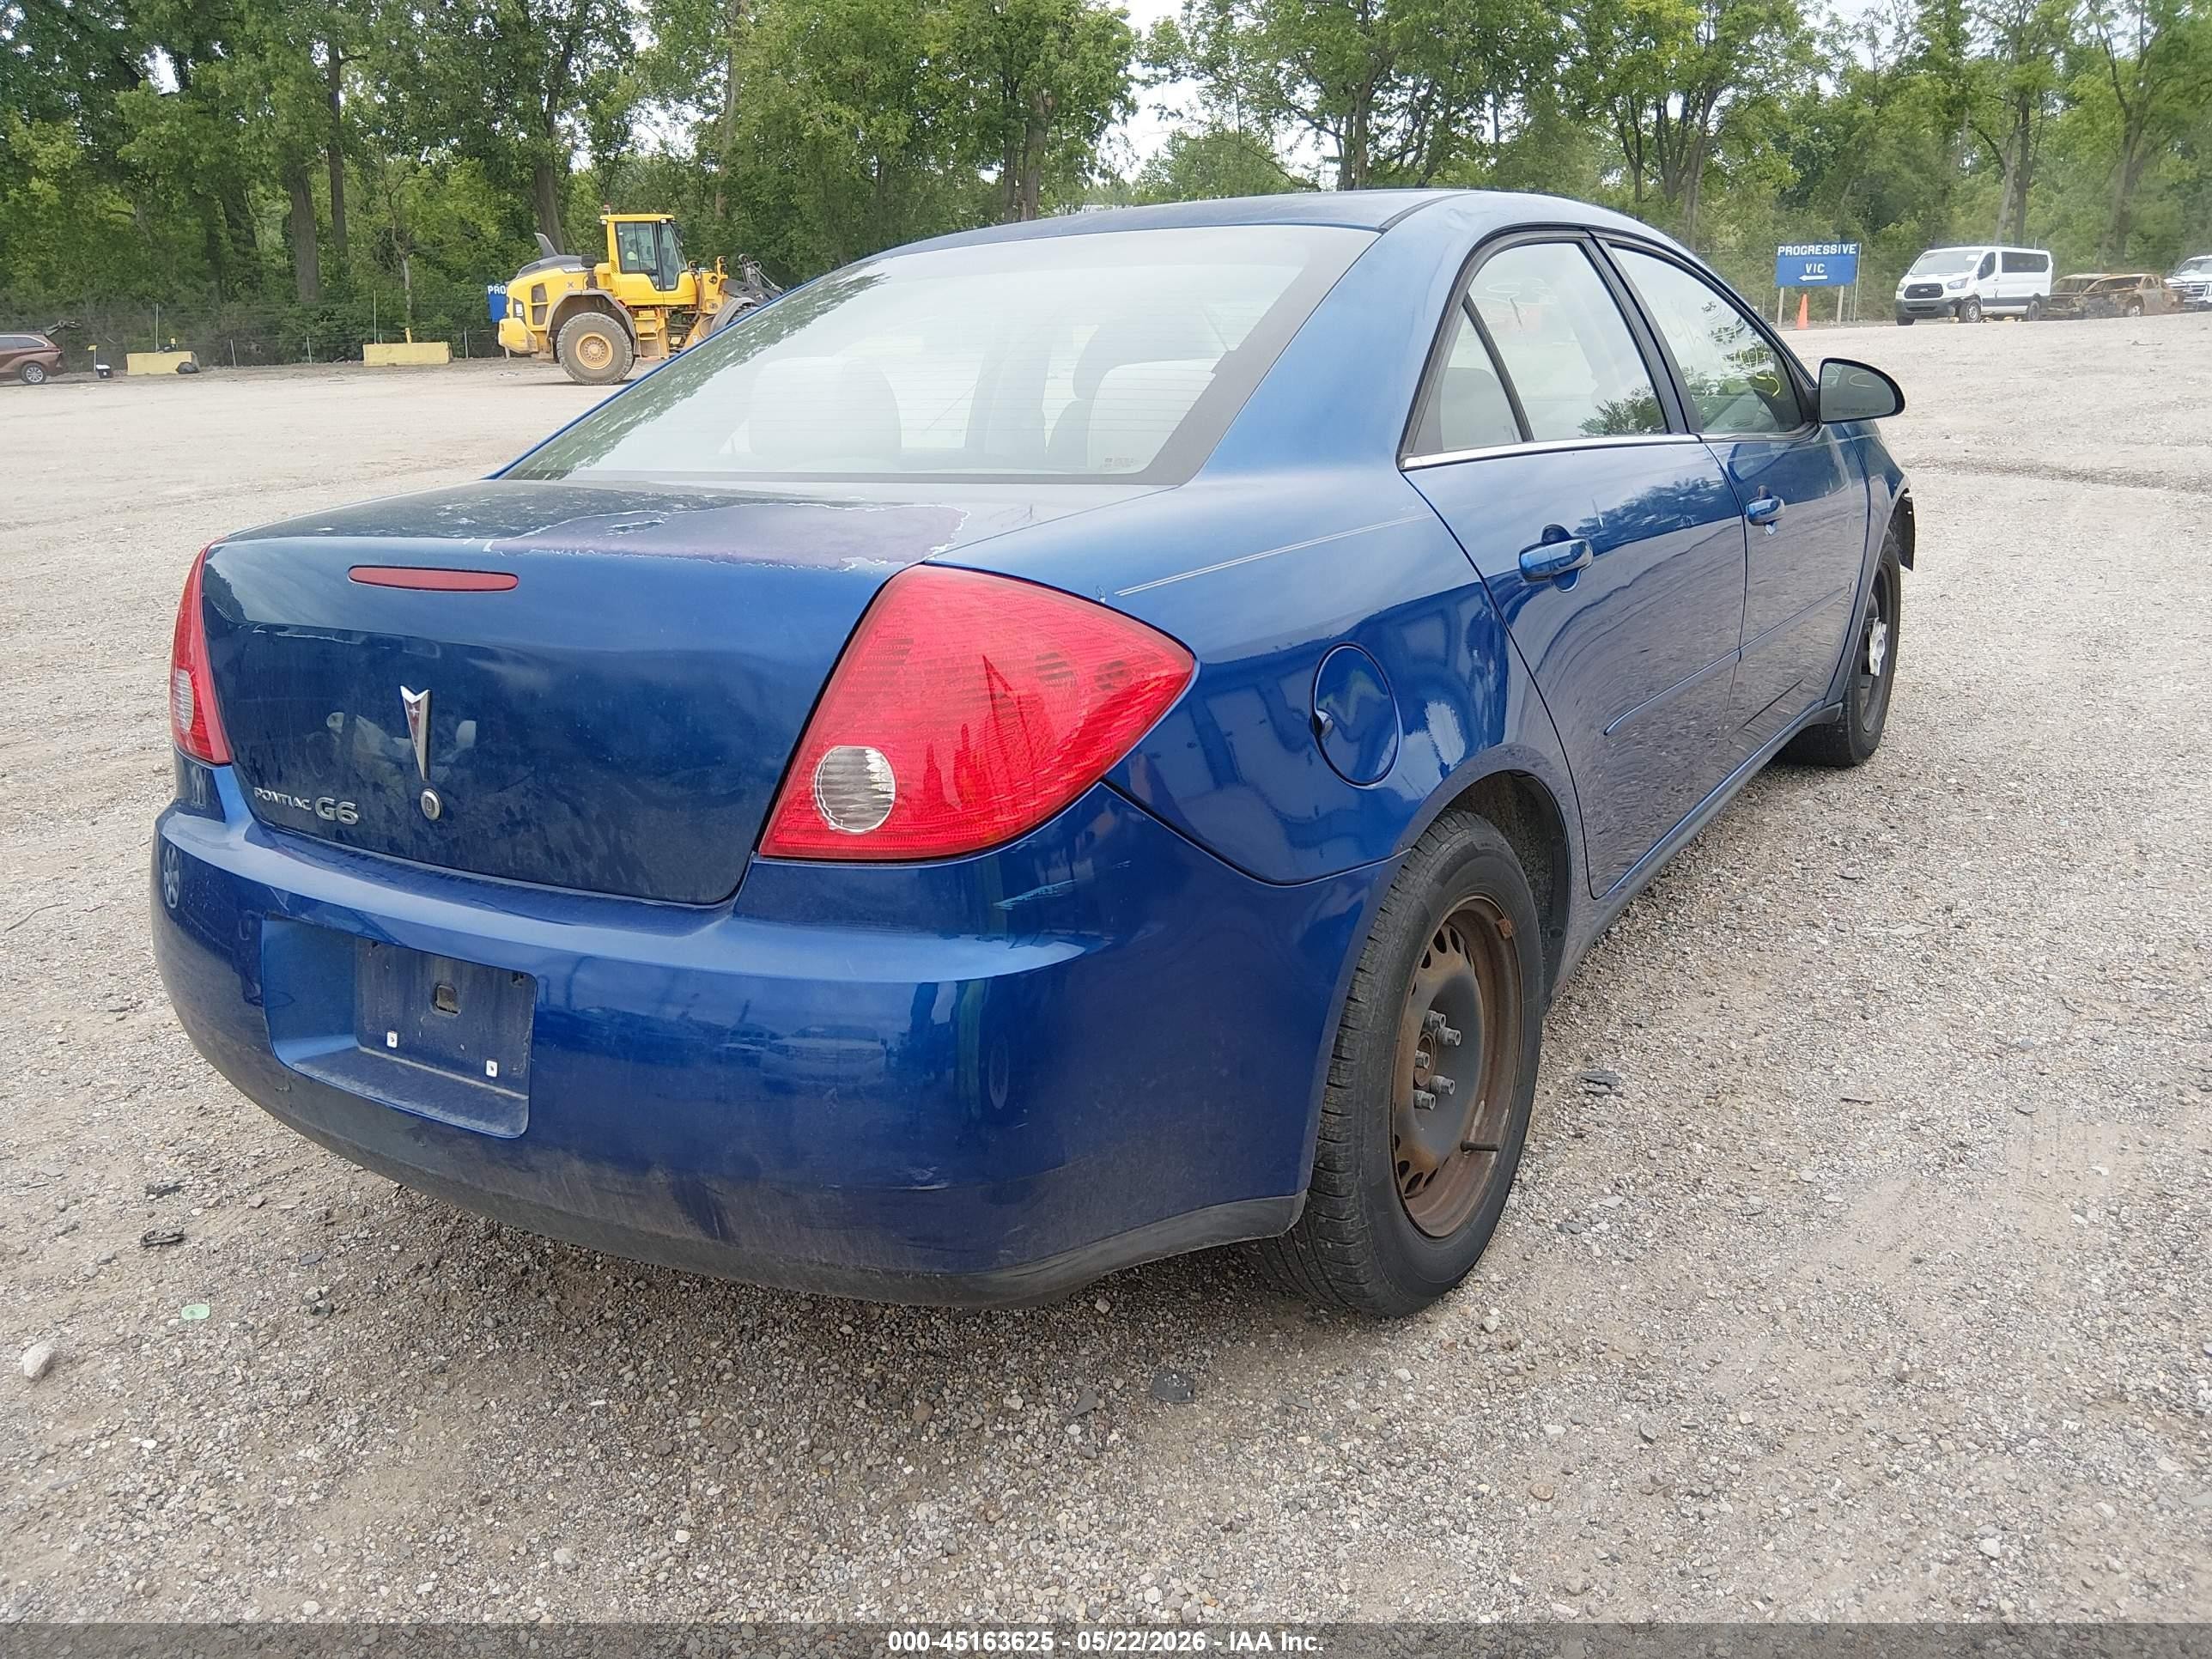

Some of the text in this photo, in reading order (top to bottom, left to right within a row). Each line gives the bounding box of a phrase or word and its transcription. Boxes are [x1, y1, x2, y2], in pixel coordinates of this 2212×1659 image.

[1778, 244, 1856, 256] PROGRESSIVE
[1805, 263, 1826, 274] VIC
[254, 787, 359, 825] PONTIAC G6
